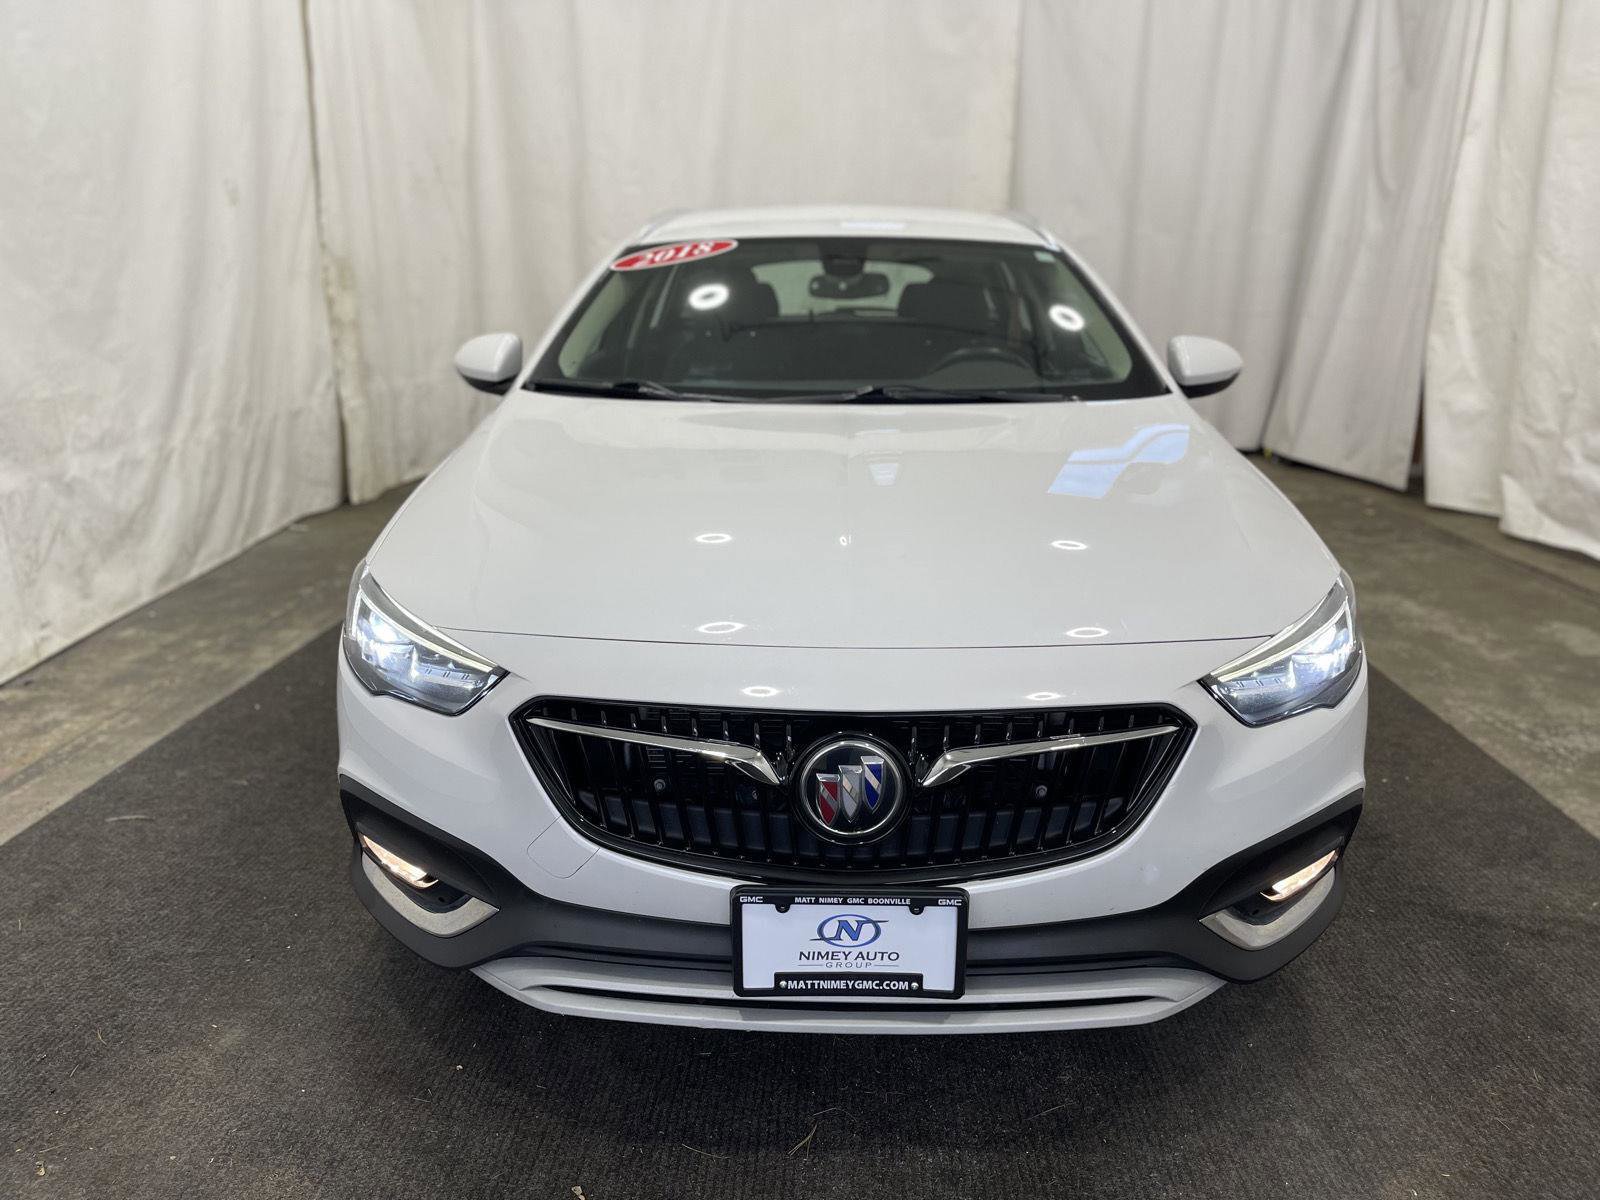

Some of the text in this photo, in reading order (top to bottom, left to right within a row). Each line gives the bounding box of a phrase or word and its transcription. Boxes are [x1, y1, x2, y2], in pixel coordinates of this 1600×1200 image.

[637, 240, 714, 268] 2018
[847, 897, 865, 905] GMC
[798, 951, 900, 962] NIMEY AUTO
[825, 961, 872, 969] GROUP
[787, 980, 909, 991] MATTNIMEYGMC.COM
